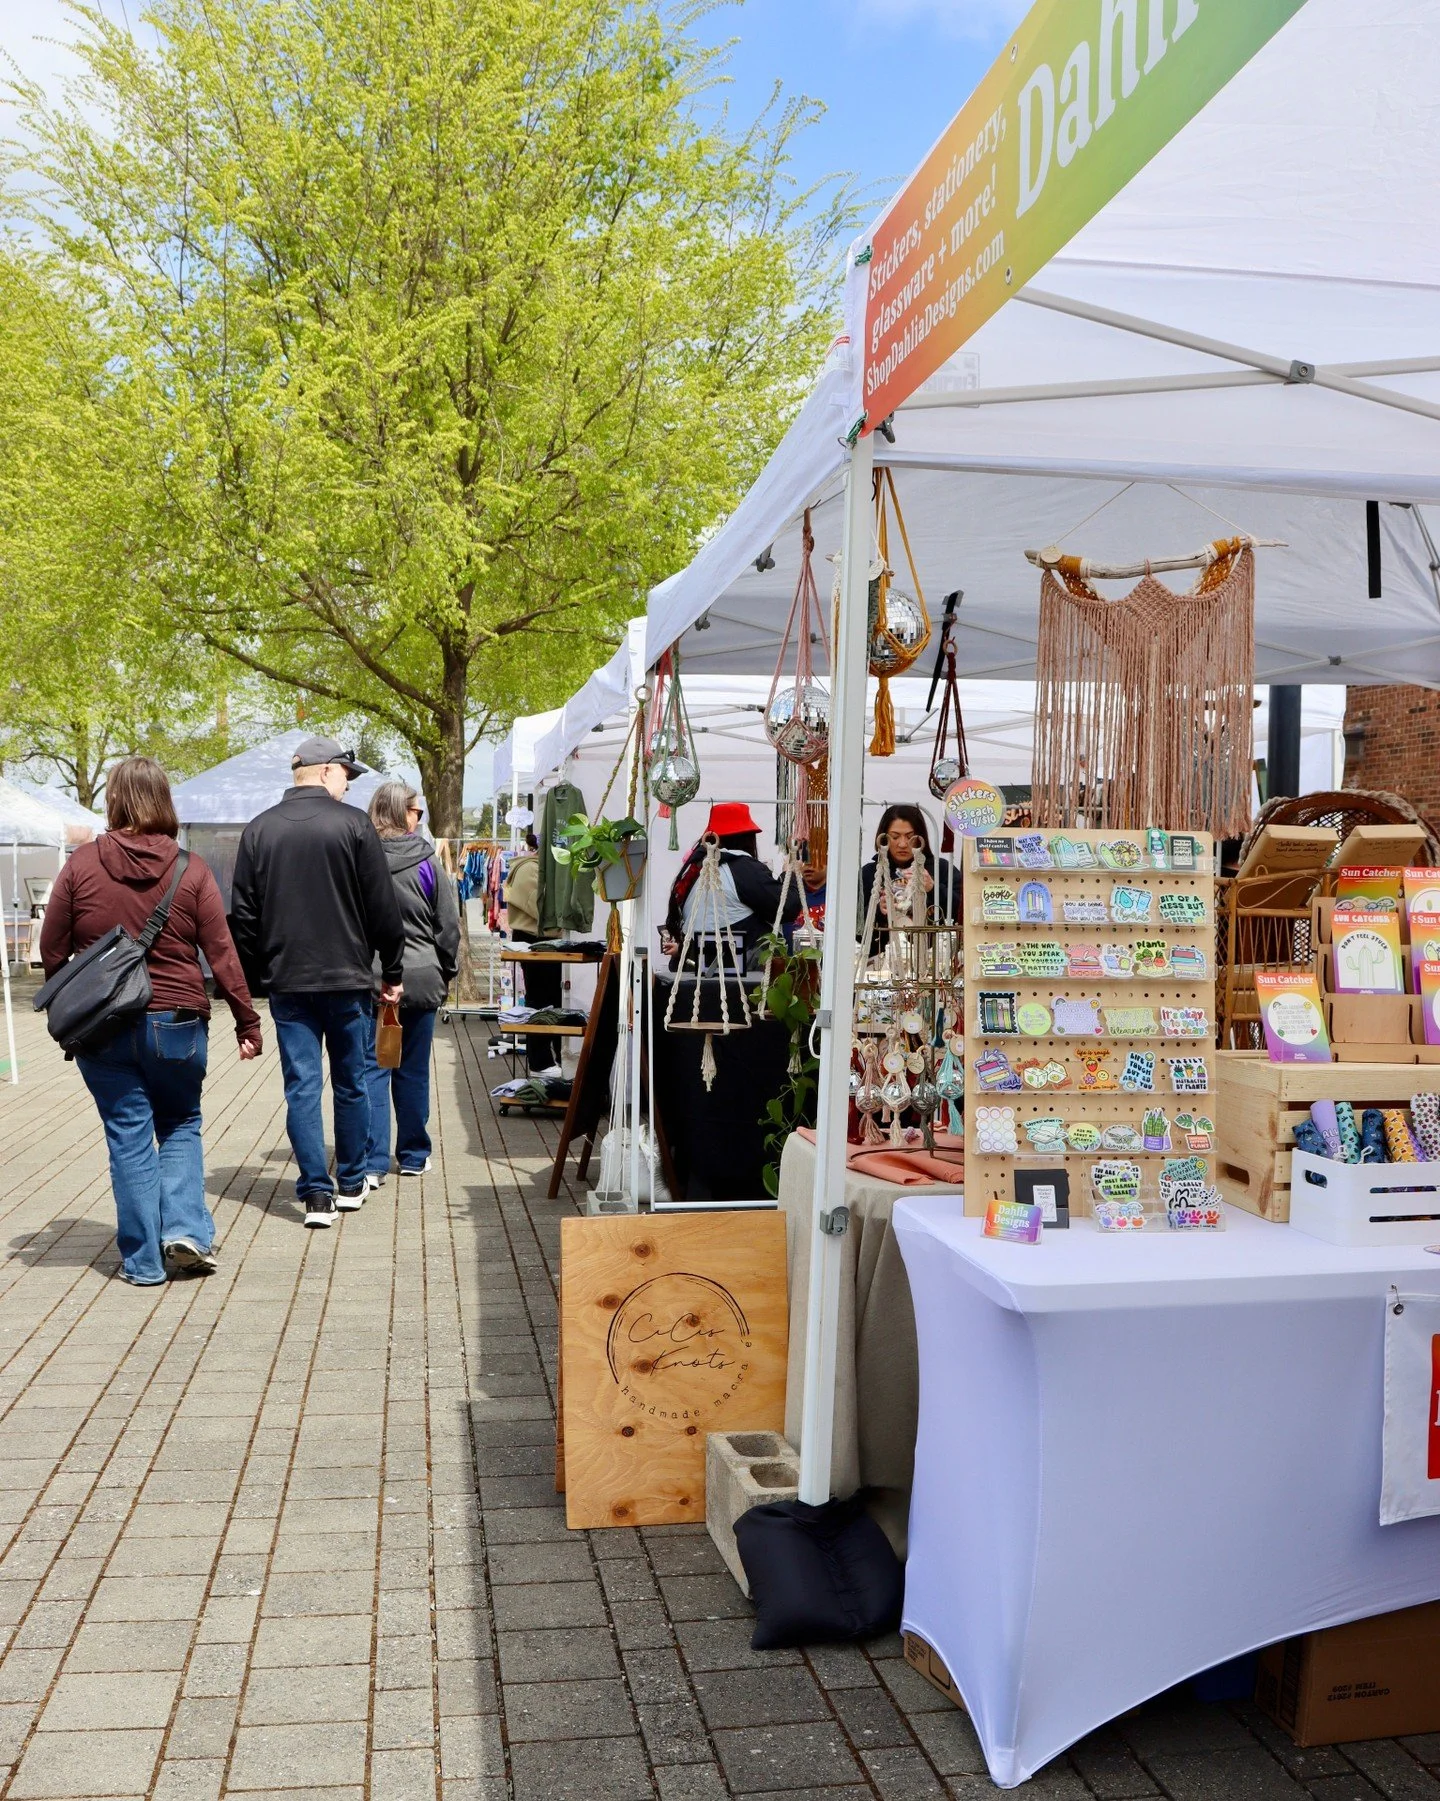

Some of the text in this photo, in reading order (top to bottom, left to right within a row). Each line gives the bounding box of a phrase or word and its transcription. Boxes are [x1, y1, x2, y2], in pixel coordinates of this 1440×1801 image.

[869, 103, 1008, 302] Stickers, stationery,
[871, 163, 998, 355] glassware + more!
[866, 230, 1006, 397] ShopDahliaDesigns.com
[947, 786, 996, 812] stickers
[956, 805, 994, 821] $3 each
[958, 813, 997, 831] or 4/$10
[1341, 868, 1401, 877] Sun Catcher
[1404, 869, 1424, 878] Sun
[1160, 895, 1174, 903] BIT
[1160, 902, 1204, 911] MESS BUT
[1333, 914, 1390, 923] SUN CATCHER
[1418, 915, 1437, 924] Sun
[1136, 940, 1166, 950] plants
[1370, 934, 1388, 950] STUCK
[1258, 975, 1314, 984] Sun Catcher
[1162, 1010, 1178, 1020] It's
[1180, 1010, 1204, 1020] okay
[1166, 1027, 1179, 1035] be
[1130, 1052, 1144, 1064] LIFE
[1126, 1068, 1140, 1077] BUT
[1130, 1061, 1152, 1076] TOUGH
[1140, 1081, 1152, 1090] YOU
[998, 1204, 1029, 1218] Dahlia
[993, 1214, 1030, 1229] Designs
[650, 1346, 736, 1376] Knots
[620, 1386, 701, 1419] handmade
[1354, 1688, 1390, 1698] CARTON
